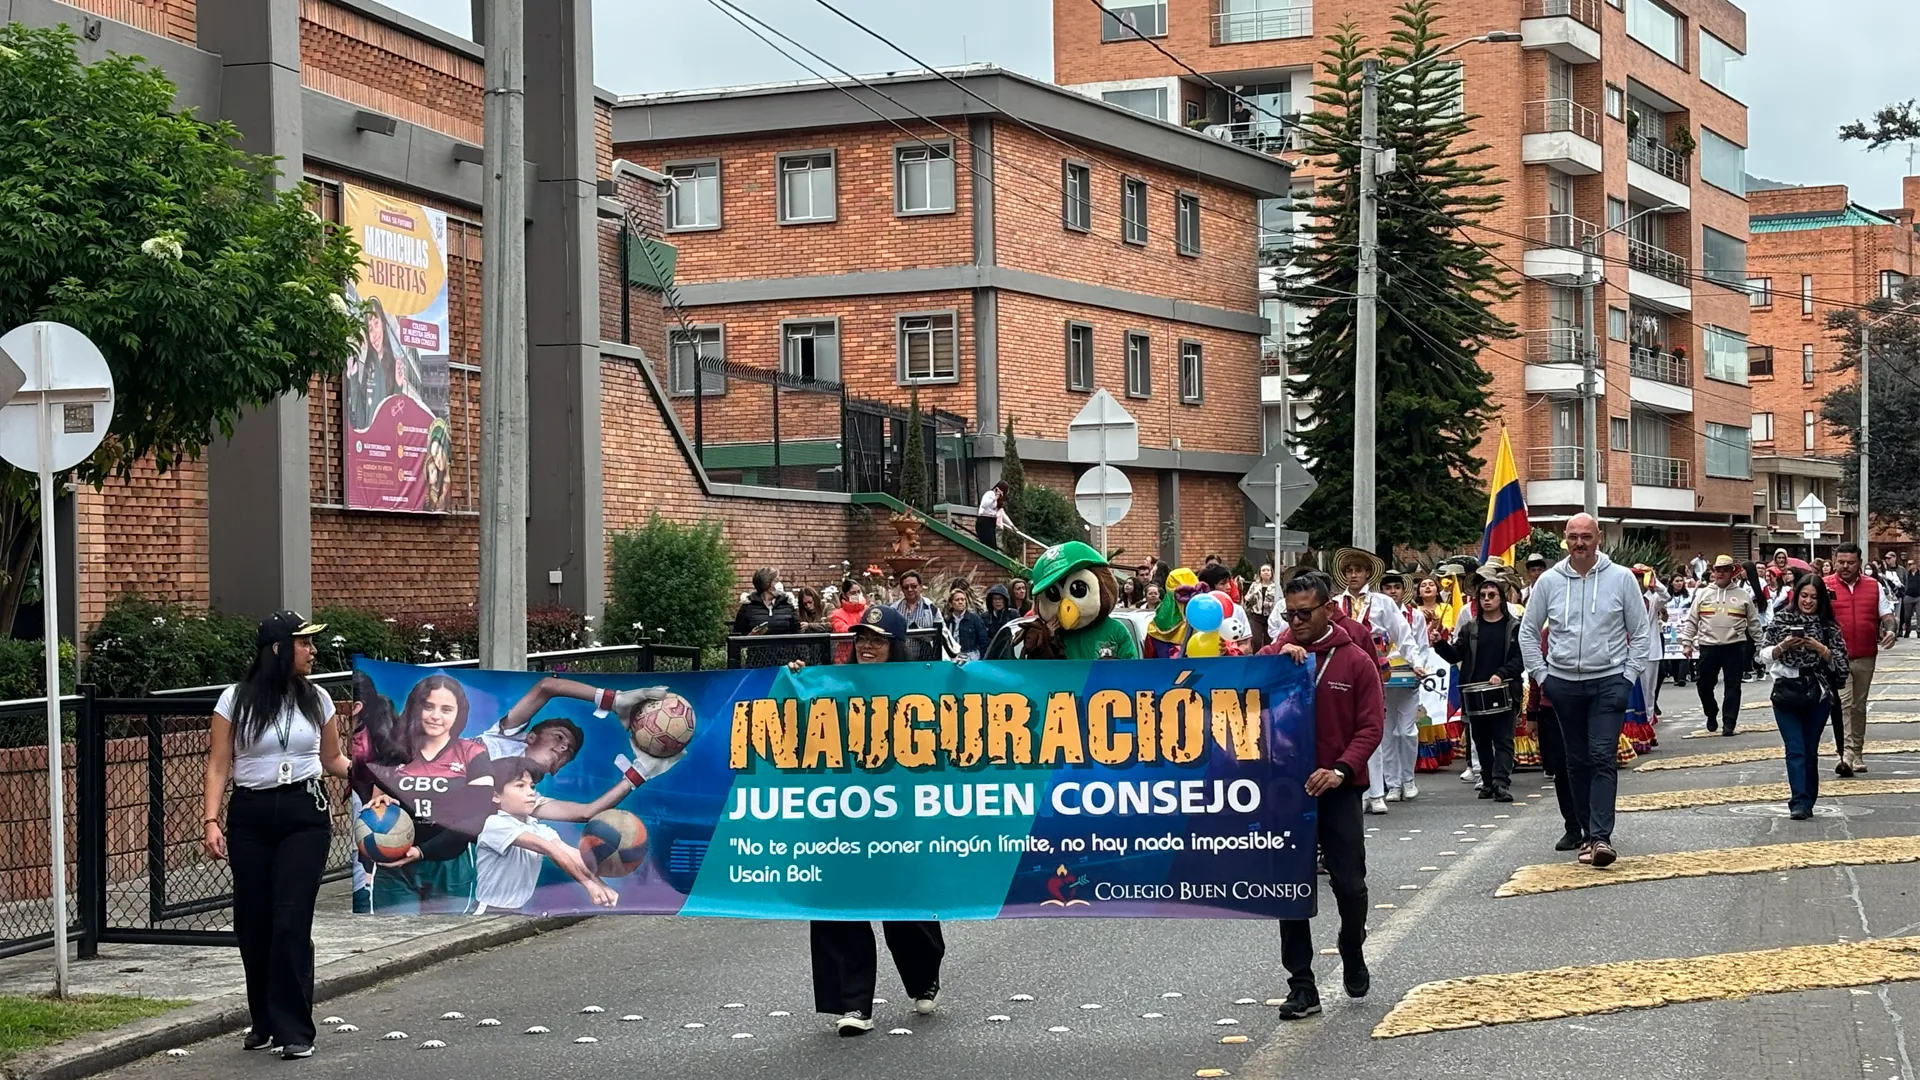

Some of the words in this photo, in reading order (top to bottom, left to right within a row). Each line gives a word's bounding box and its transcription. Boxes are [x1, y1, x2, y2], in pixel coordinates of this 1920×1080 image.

[364, 224, 428, 270] MATRICULAS
[368, 259, 427, 296] ABIERTAS
[729, 669, 1262, 769] INAUGURACIÓN
[398, 776, 449, 793] CBC
[729, 785, 898, 820] JUEGOS
[914, 783, 1035, 817] BUEN
[1051, 779, 1261, 816] CONSEJO
[413, 798, 432, 818] 13
[729, 837, 763, 855] "No
[769, 839, 787, 855] te
[793, 837, 861, 859] puedes
[867, 840, 922, 858] poner
[929, 835, 992, 857] ningún
[998, 835, 1055, 854] límite,
[1061, 839, 1085, 852] no
[1091, 833, 1127, 855] hay
[1134, 833, 1184, 851] nada
[729, 865, 781, 883] Usain
[787, 864, 822, 882] Bolt
